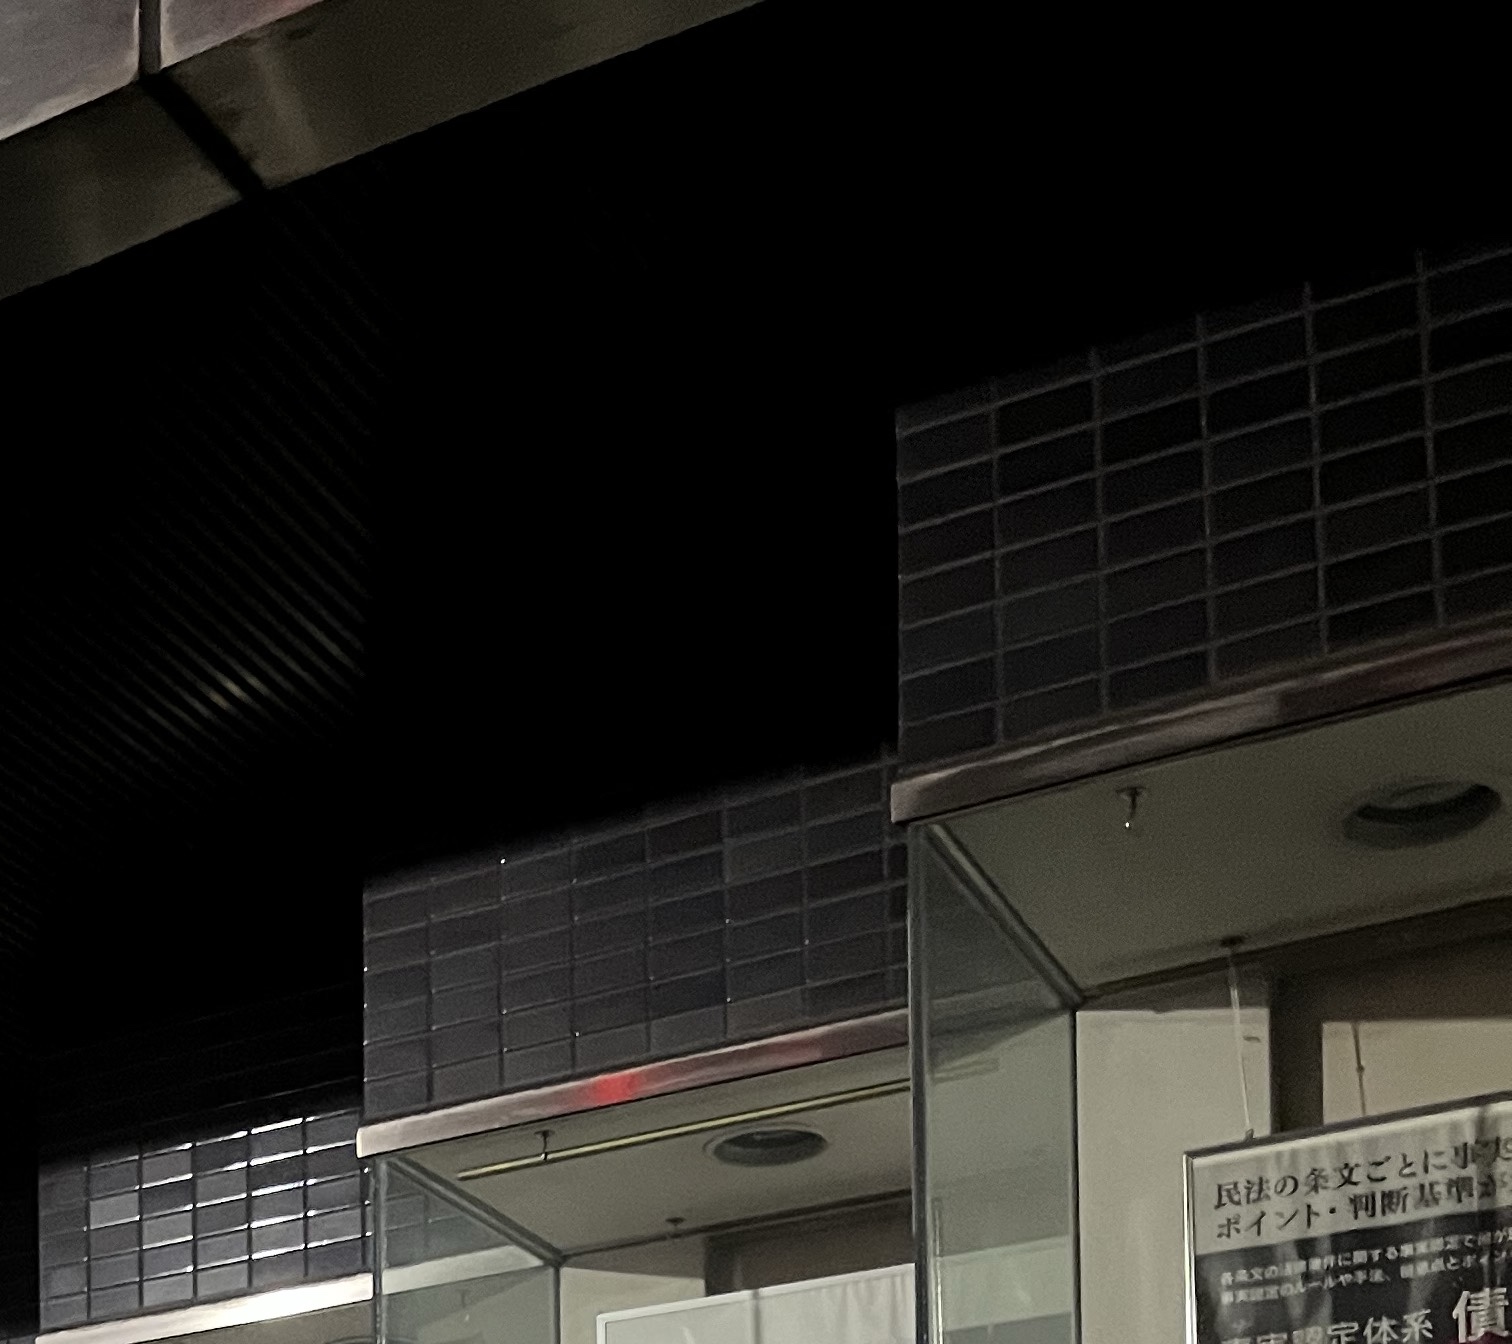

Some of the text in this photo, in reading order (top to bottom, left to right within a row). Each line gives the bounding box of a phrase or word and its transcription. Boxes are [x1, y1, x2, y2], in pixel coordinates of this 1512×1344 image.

[1214, 1136, 1512, 1210] 民法の条文ごとに
